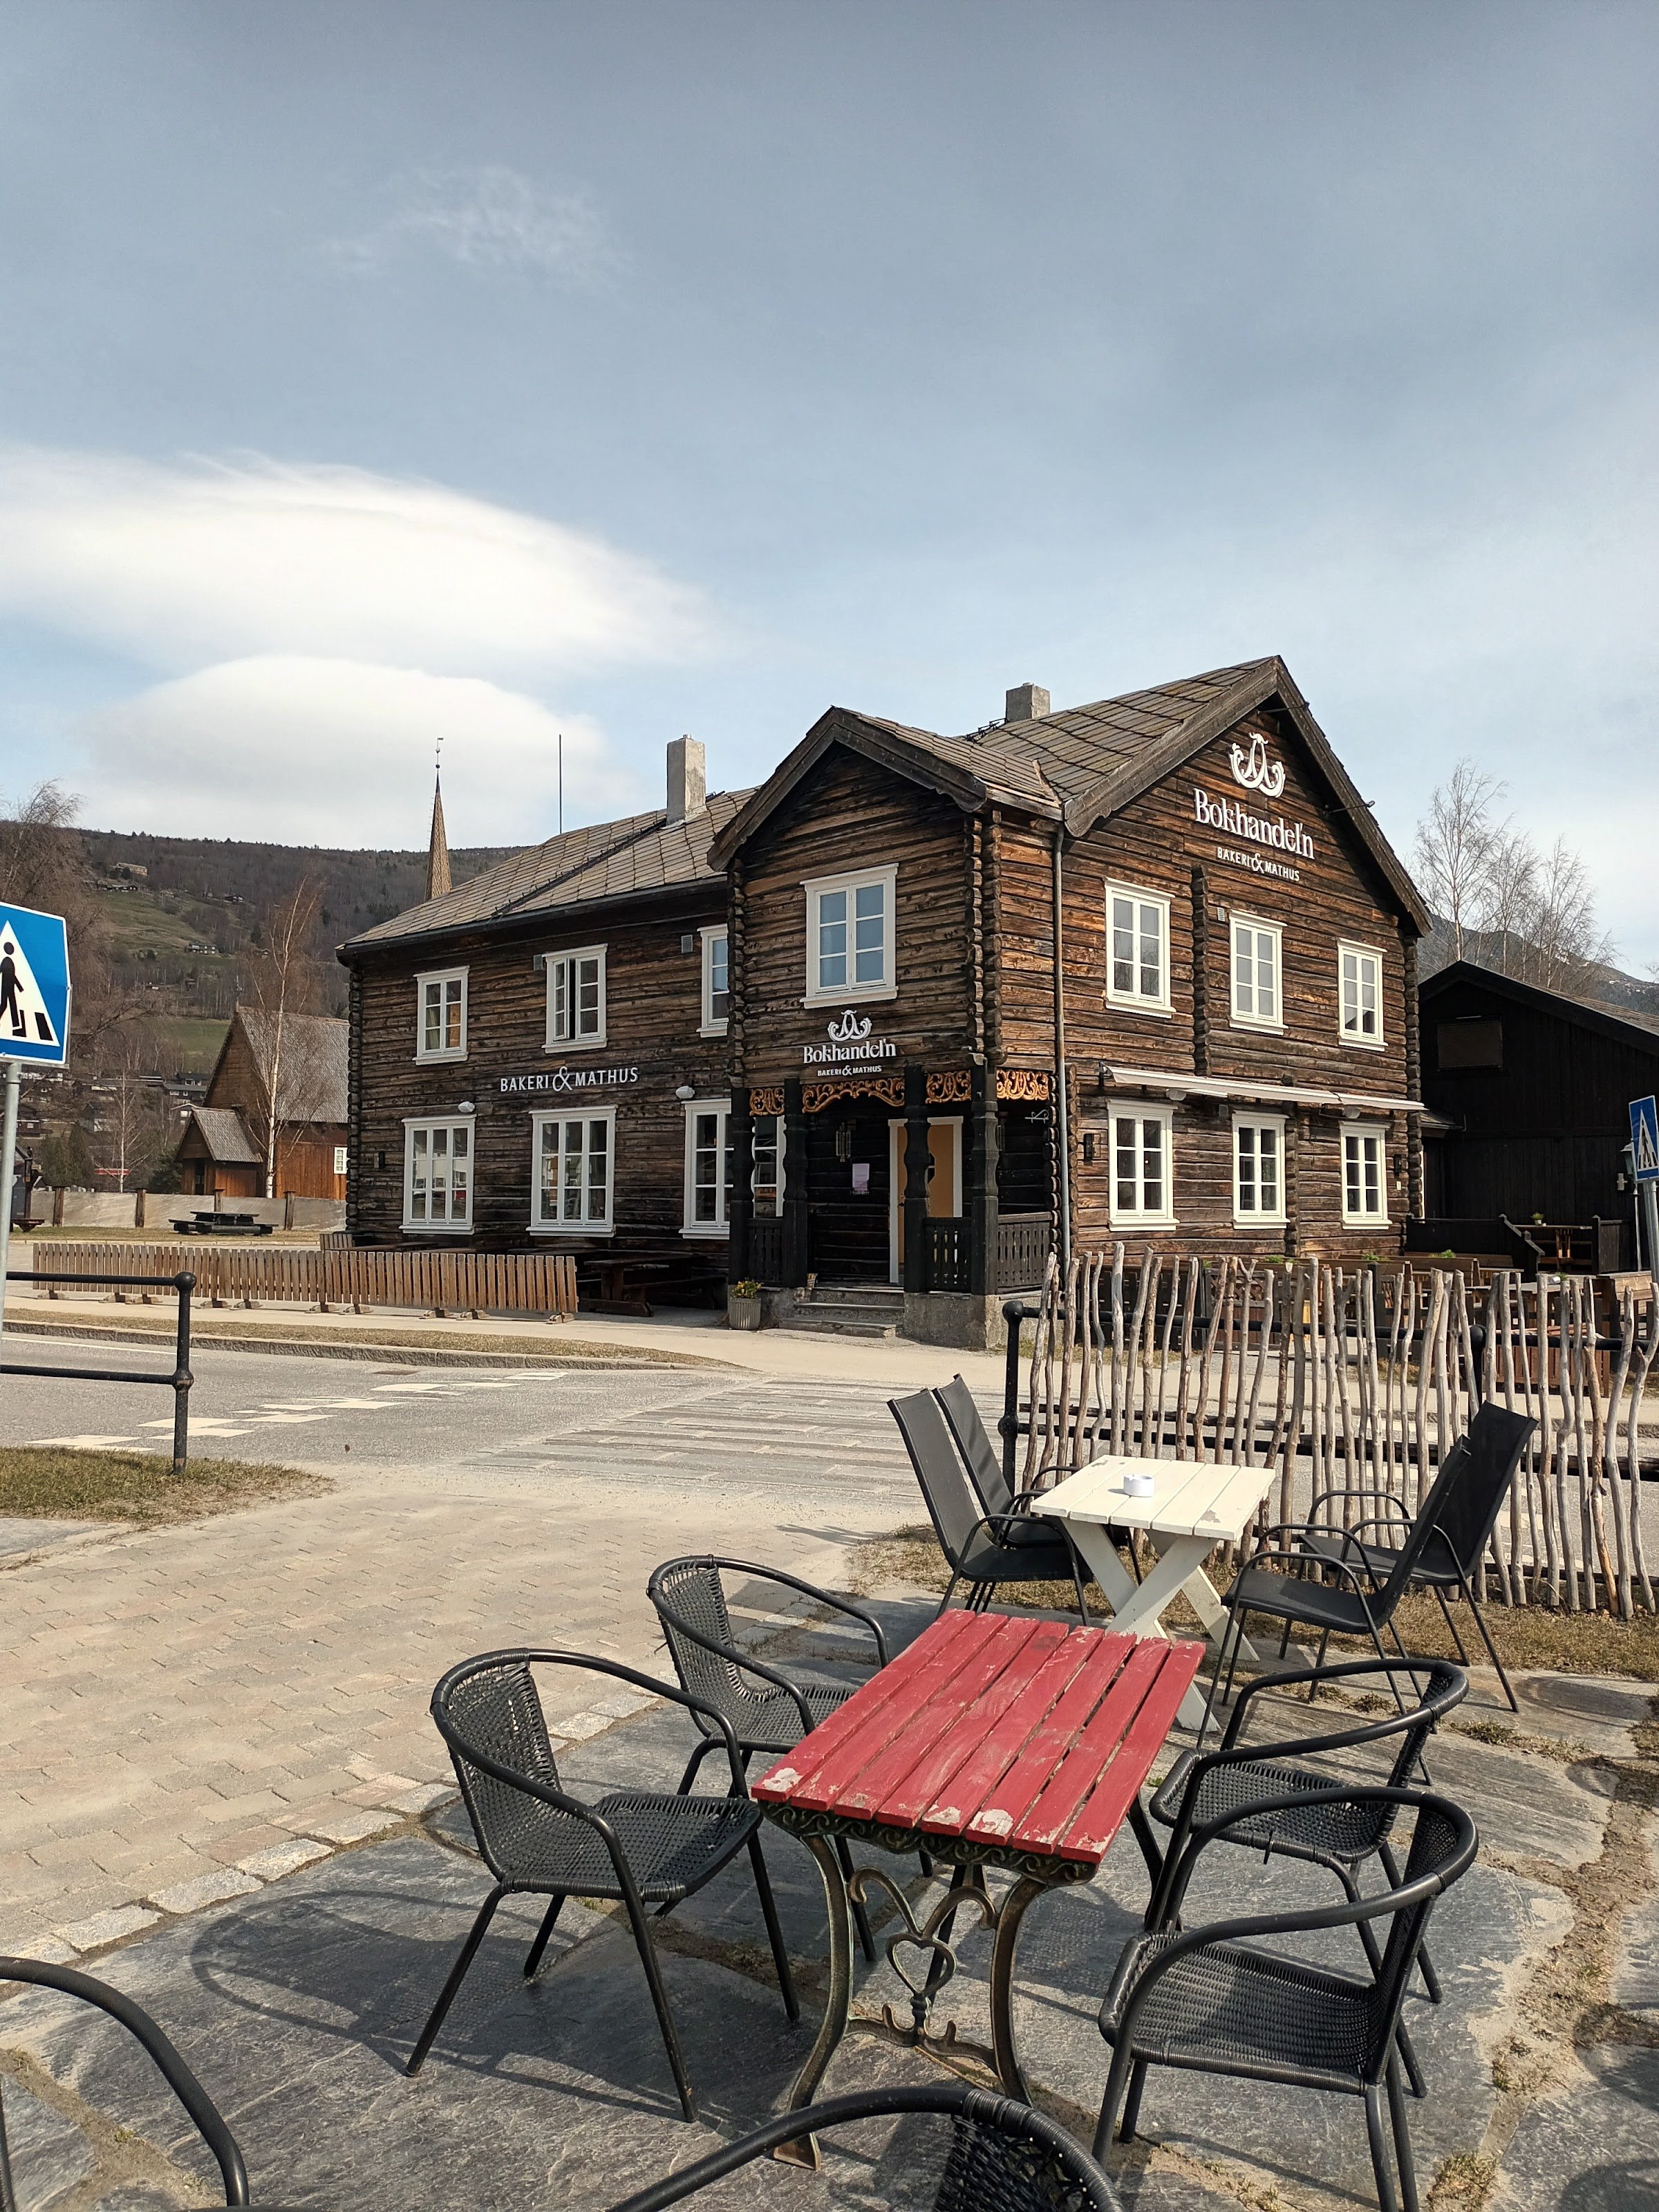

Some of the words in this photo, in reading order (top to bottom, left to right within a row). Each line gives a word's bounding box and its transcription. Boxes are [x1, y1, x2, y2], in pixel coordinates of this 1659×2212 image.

[1217, 846, 1250, 866] BAKERI
[1265, 861, 1300, 881] MATHUS
[500, 1075, 549, 1092] BAKERI
[552, 1066, 573, 1092] &
[575, 1067, 639, 1087] MATHUS
[852, 1065, 882, 1074] MATHUS
